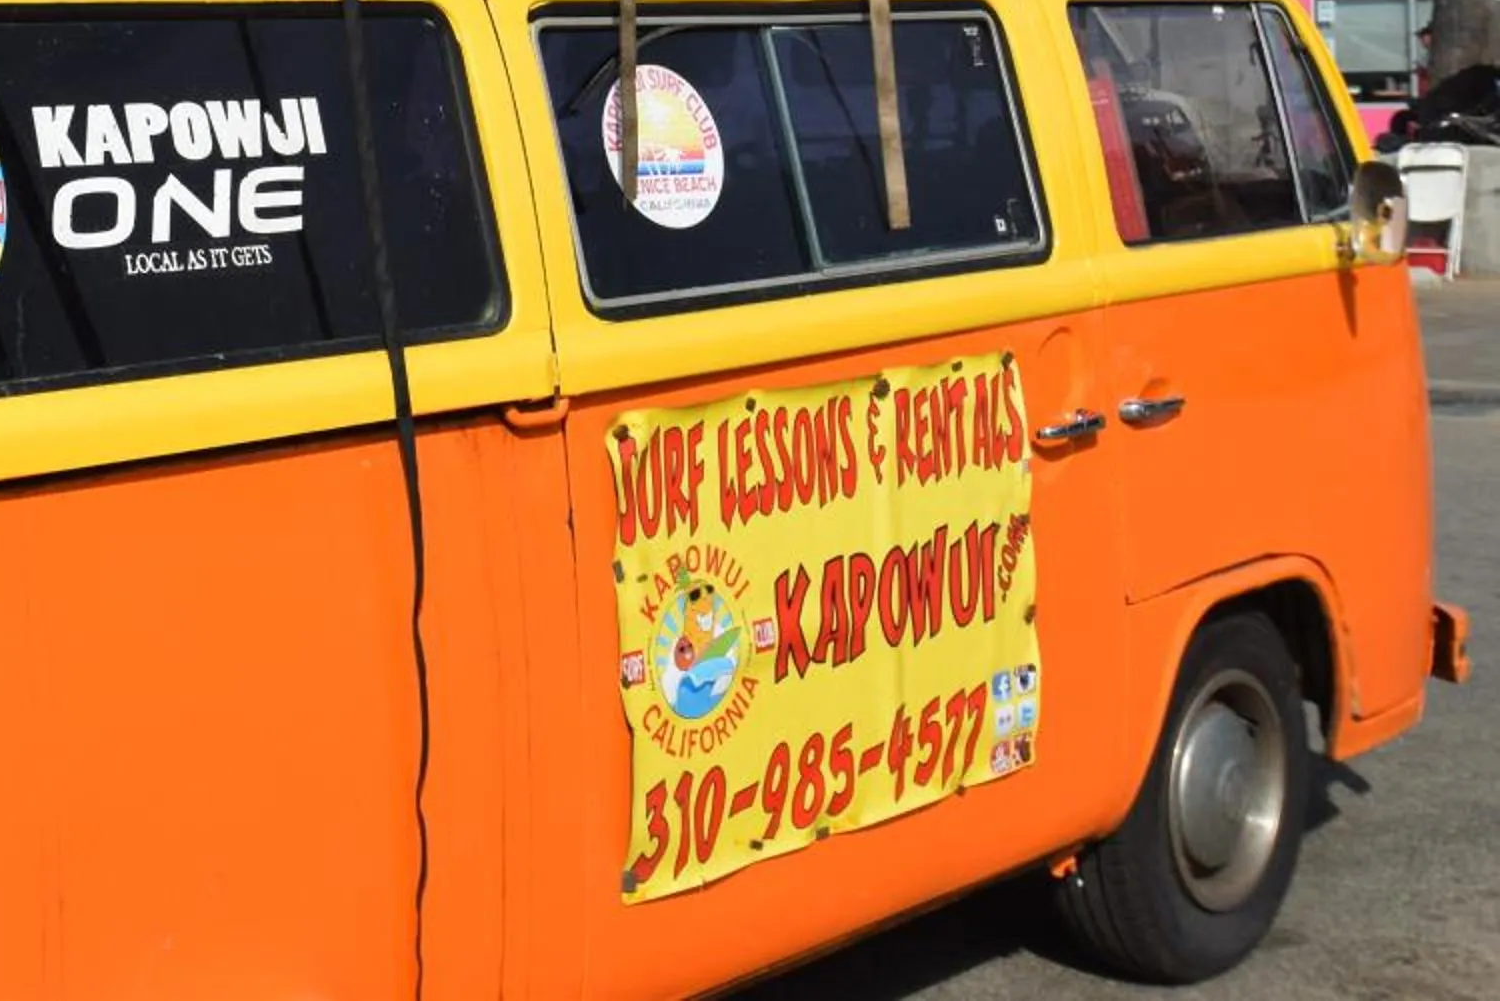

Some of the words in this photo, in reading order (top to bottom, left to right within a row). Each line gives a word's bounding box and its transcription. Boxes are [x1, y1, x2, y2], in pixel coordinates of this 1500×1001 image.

[647, 68, 685, 96] SURF
[686, 92, 718, 150] CLUB
[52, 166, 305, 250] ONE
[674, 176, 717, 193] BEACH
[124, 251, 185, 276] LOCAL
[187, 249, 208, 272] AS
[208, 247, 229, 269] IT
[231, 244, 274, 267] GETS
[617, 419, 705, 548] SURF
[717, 394, 858, 533] LESSONS
[640, 544, 750, 626] KAPOWUI
[774, 519, 1000, 684] KAPOWUI
[642, 675, 760, 759] CALIFORNIA
[630, 682, 988, 884] 310-985-4577
